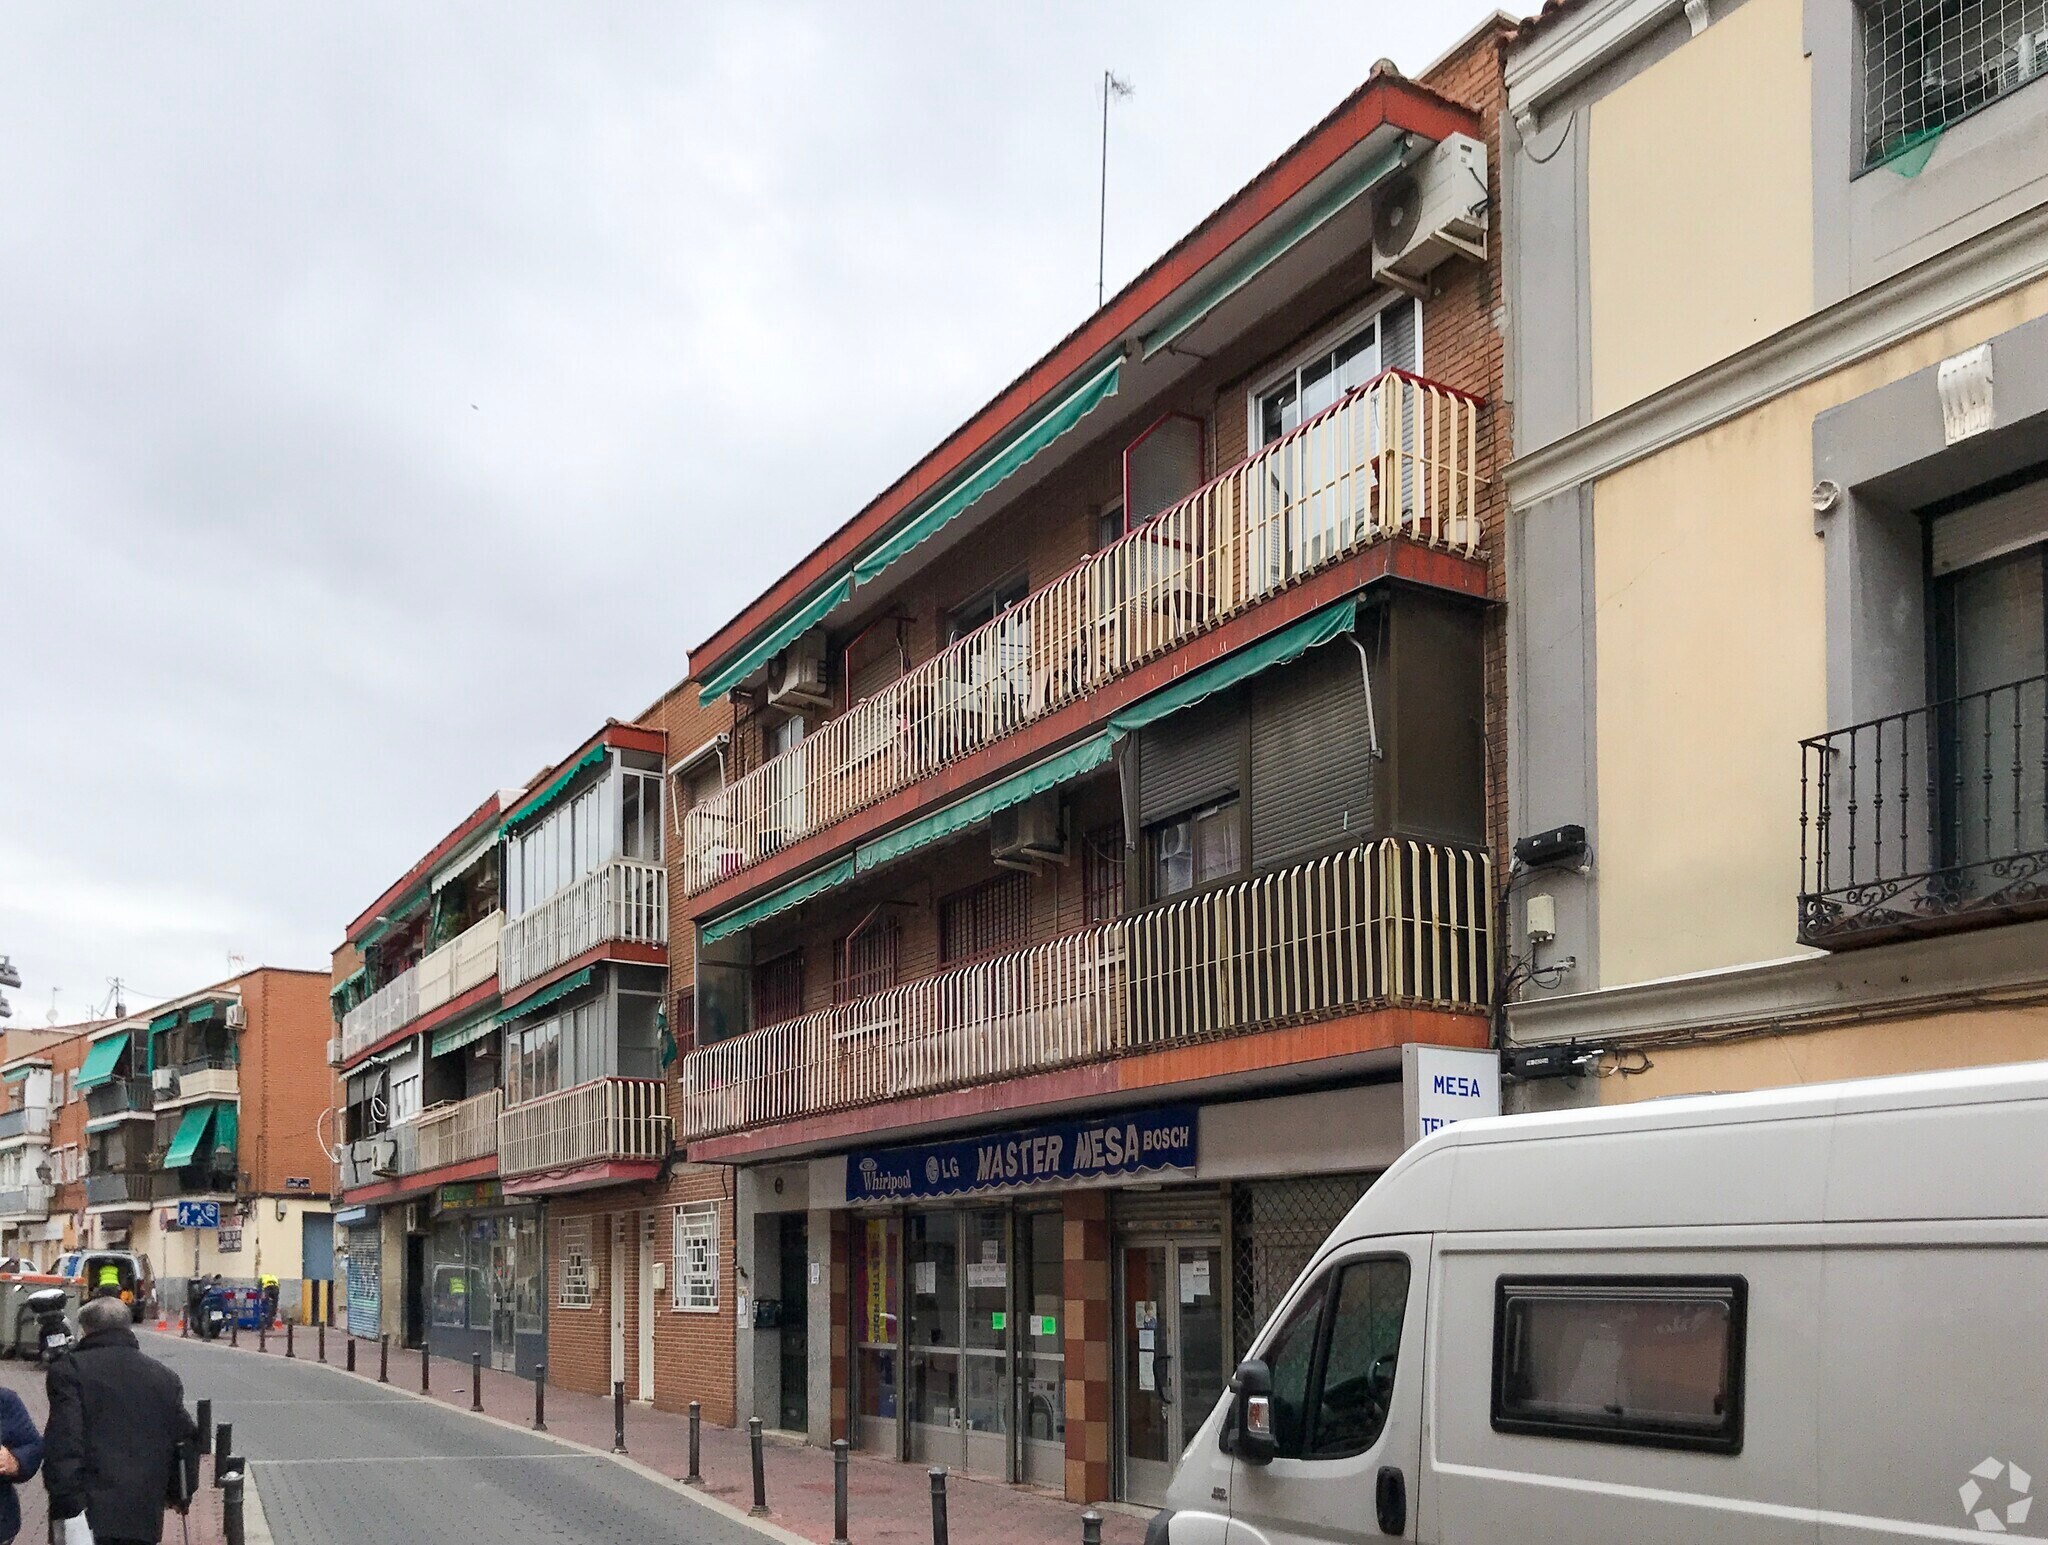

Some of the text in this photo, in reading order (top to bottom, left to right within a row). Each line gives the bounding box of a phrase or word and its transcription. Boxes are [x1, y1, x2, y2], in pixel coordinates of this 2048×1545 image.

[1434, 1075, 1481, 1098] MESA
[863, 1124, 1190, 1194] Whirlpool LG MASTER MESA BOSCH
